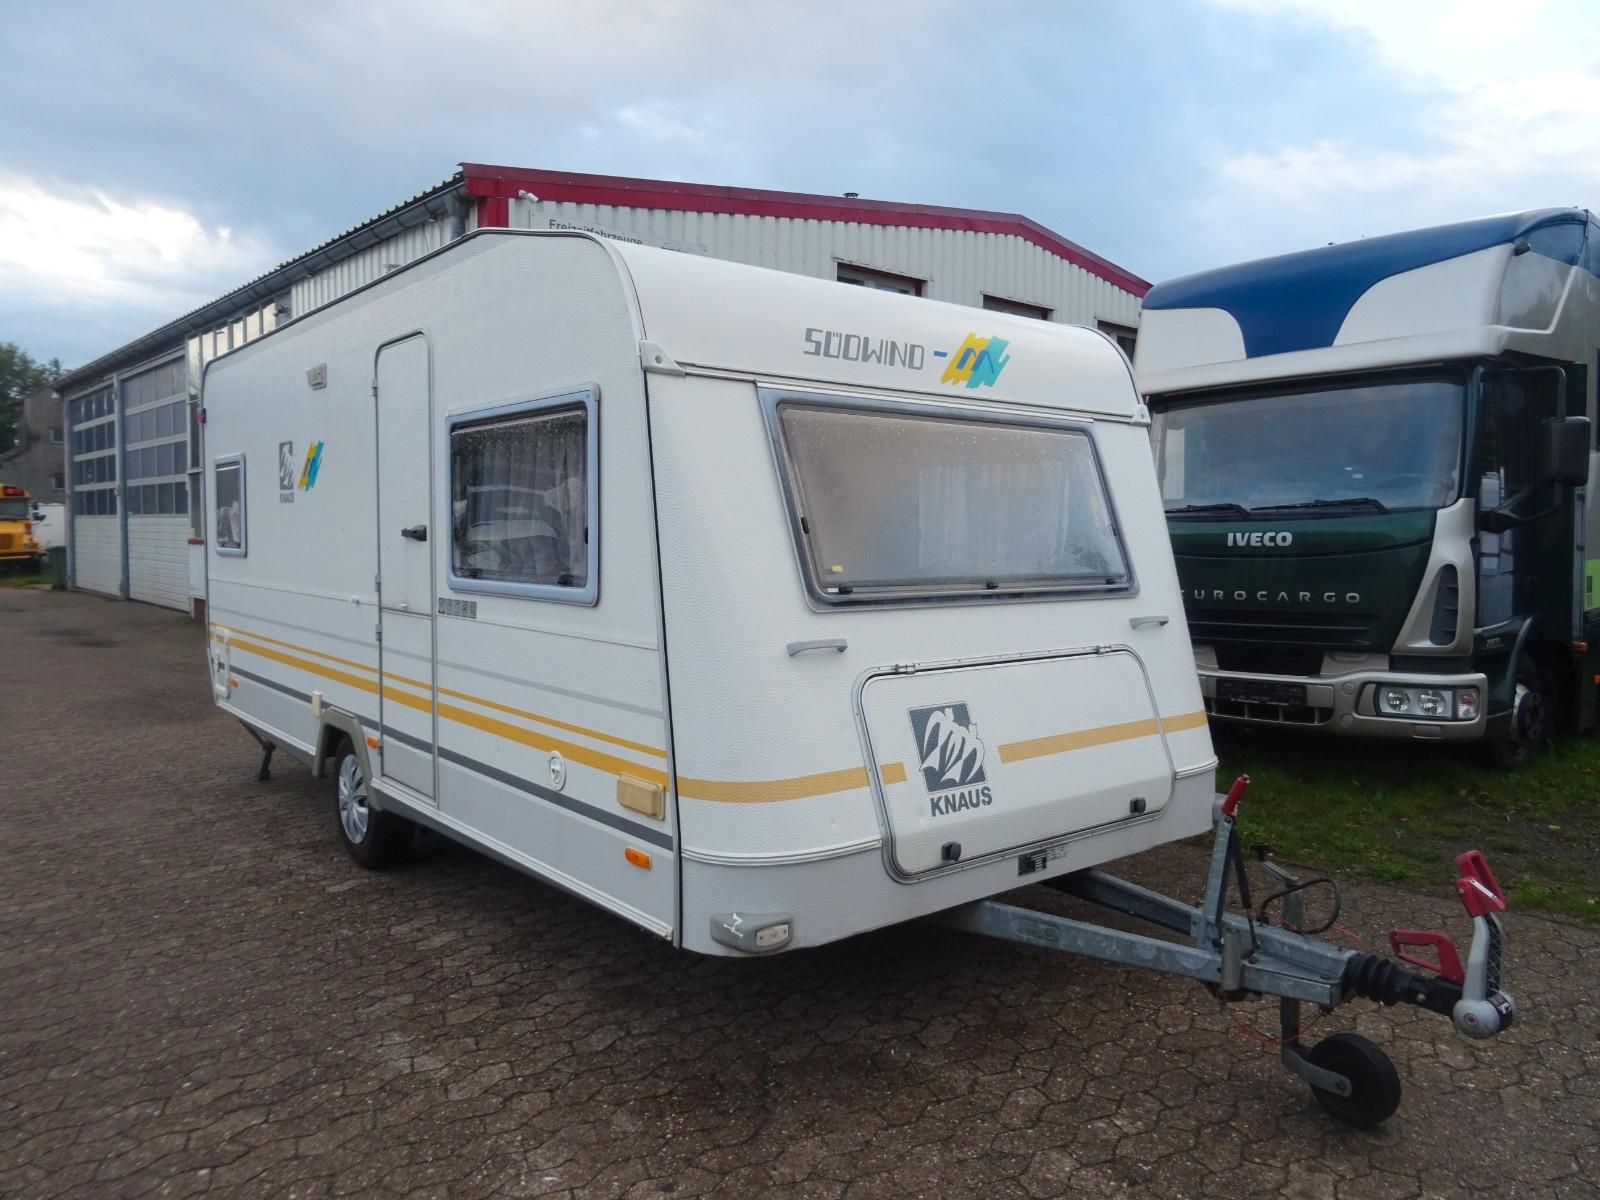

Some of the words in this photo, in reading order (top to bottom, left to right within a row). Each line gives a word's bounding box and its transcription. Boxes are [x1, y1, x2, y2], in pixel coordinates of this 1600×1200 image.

[803, 327, 925, 370] SÜDWIND
[1226, 532, 1293, 547] IVECO
[930, 785, 993, 817] KNAUS
